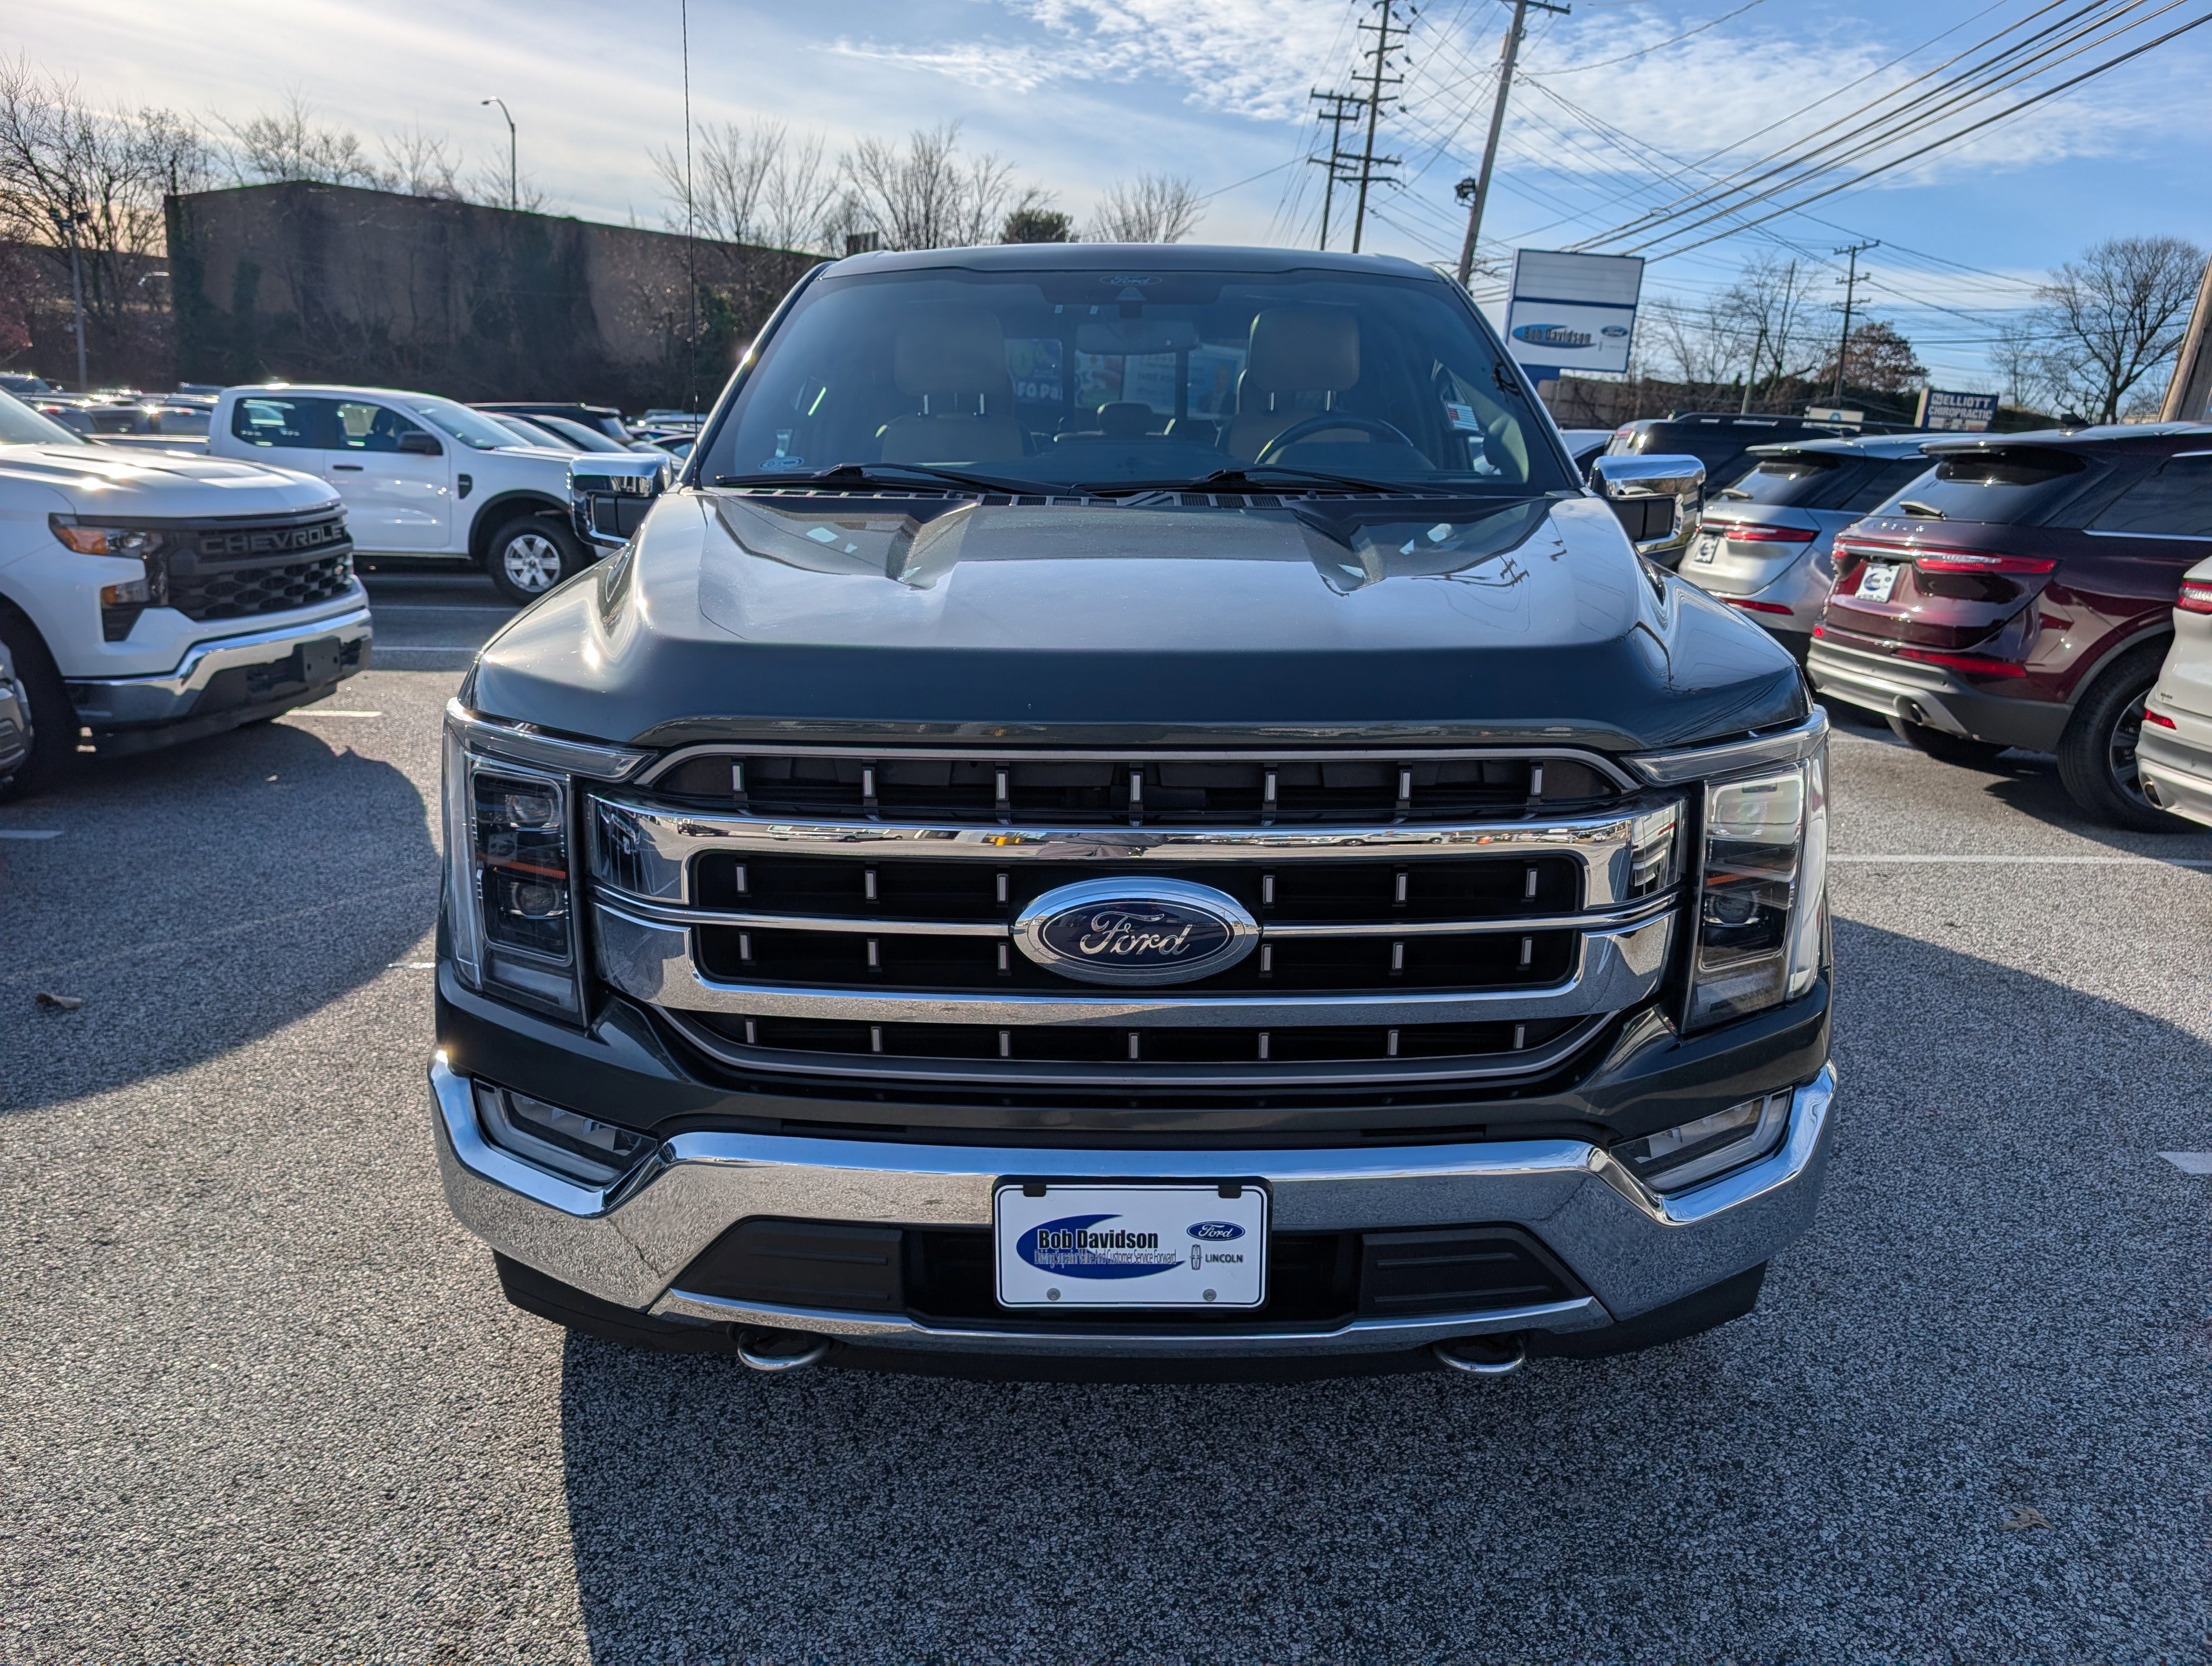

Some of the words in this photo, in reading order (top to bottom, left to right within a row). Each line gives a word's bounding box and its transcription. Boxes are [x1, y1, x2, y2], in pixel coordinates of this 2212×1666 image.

[1524, 326, 1542, 339] Bob
[1545, 328, 1591, 343] Davidson
[1944, 394, 1991, 408] ELLIOTT
[1928, 405, 1994, 421] CHIROPRACTIC
[1079, 911, 1193, 955] Ford
[1198, 1223, 1232, 1238] Ford
[1038, 1229, 1073, 1249] Bob
[1077, 1229, 1159, 1249] Davidson
[1107, 1248, 1133, 1264] Customer
[1134, 1248, 1153, 1264] Service
[1154, 1248, 1176, 1264] Forward
[1205, 1253, 1243, 1264] LINCOLN
